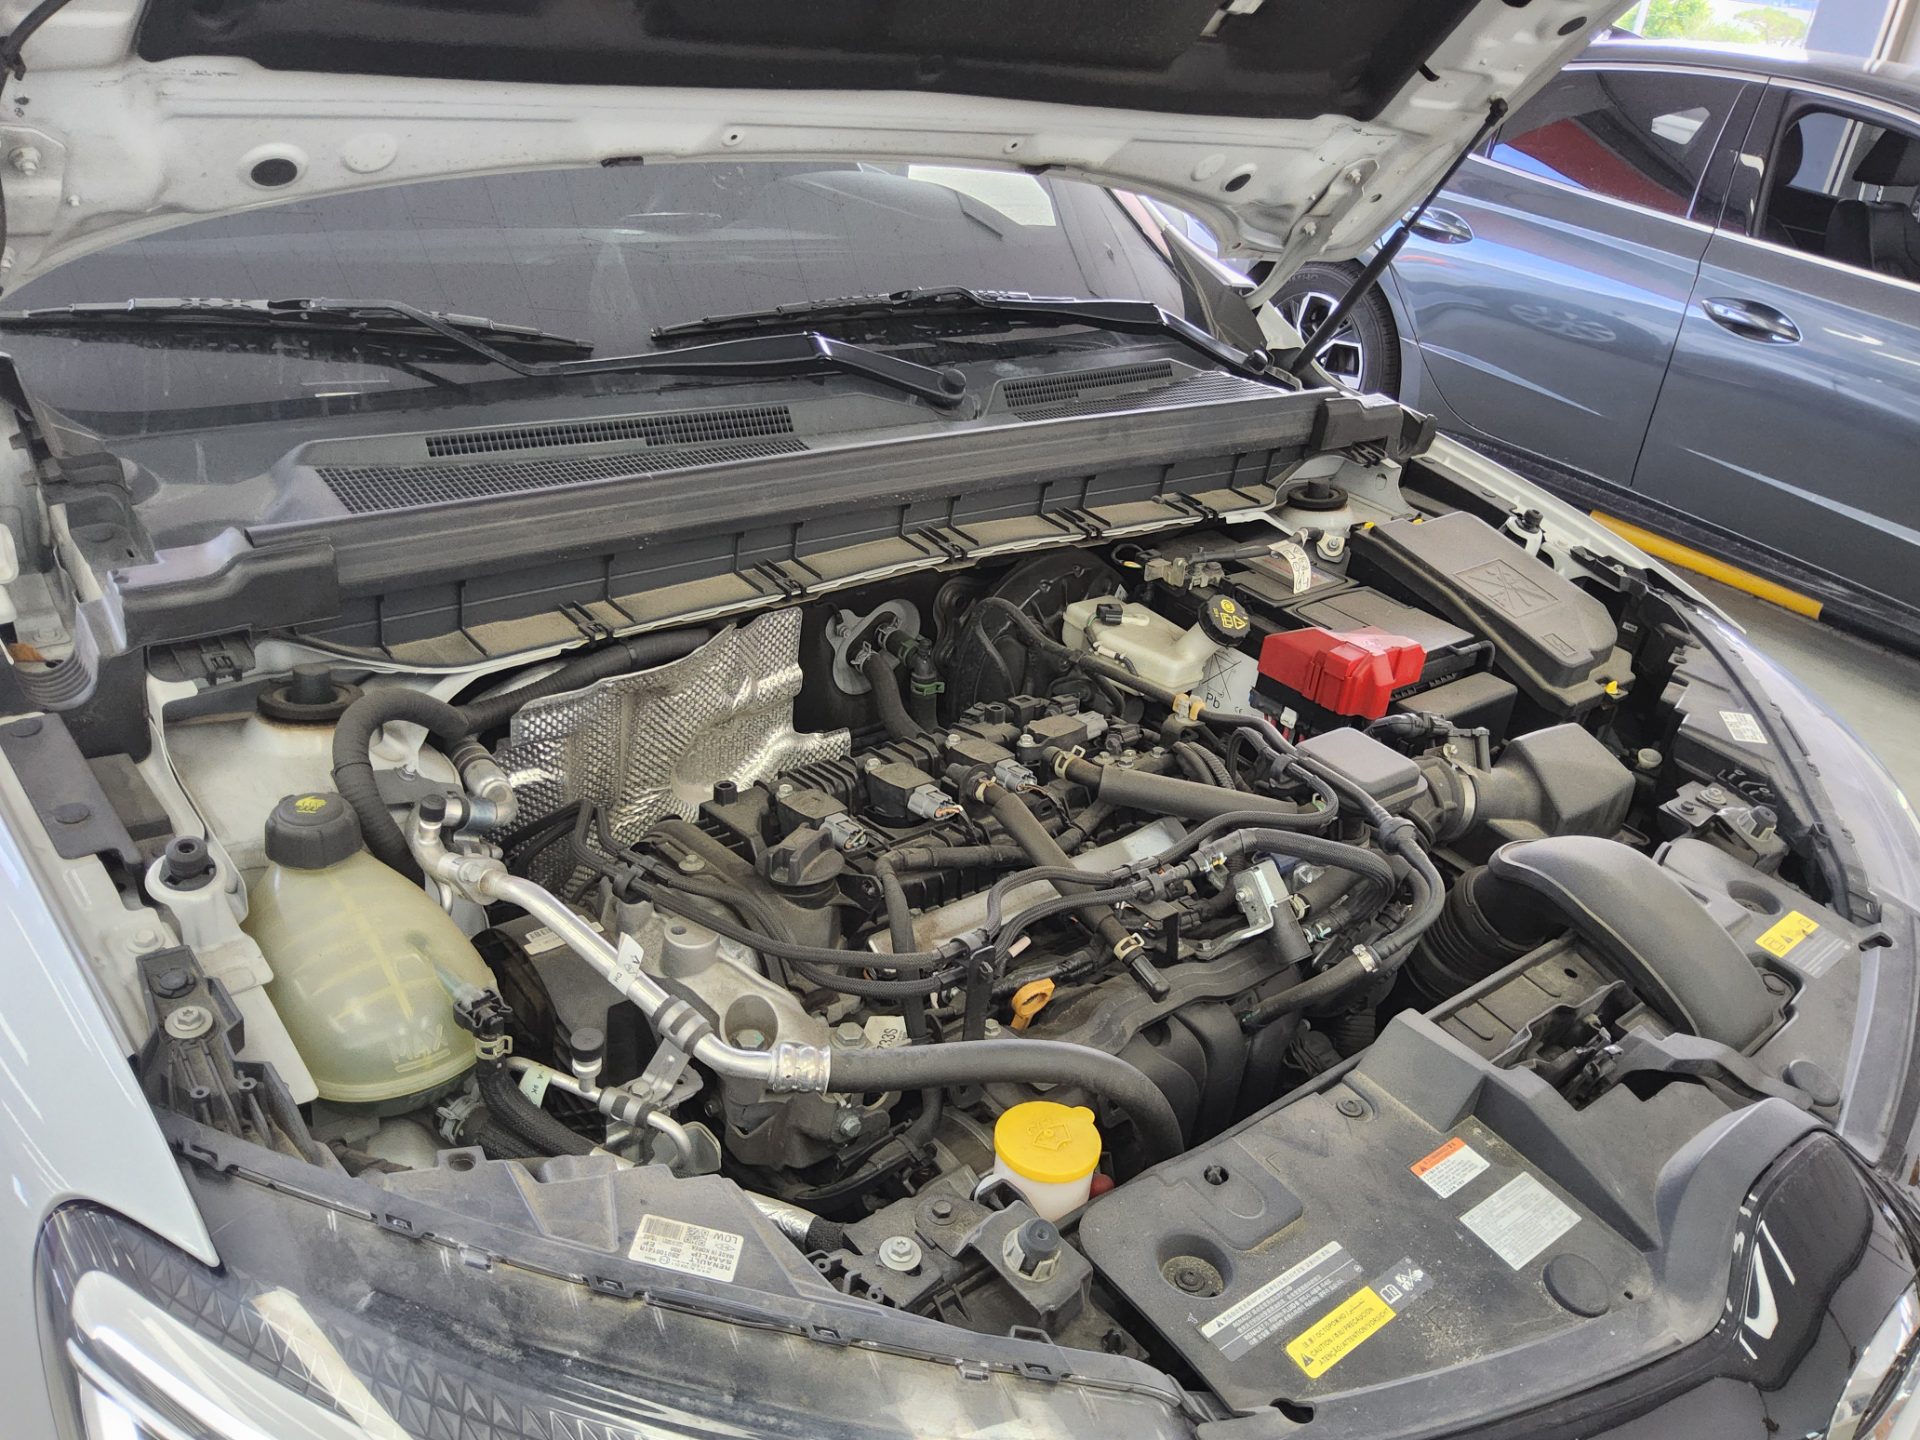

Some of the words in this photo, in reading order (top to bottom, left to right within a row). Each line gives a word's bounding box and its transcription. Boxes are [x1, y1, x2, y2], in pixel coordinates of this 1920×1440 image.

[1206, 692, 1220, 709] Pb
[387, 1024, 449, 1063] MAX
[713, 1233, 738, 1244] LOW
[688, 1255, 731, 1271] RENAULT
[1310, 1336, 1334, 1356] CAUTION
